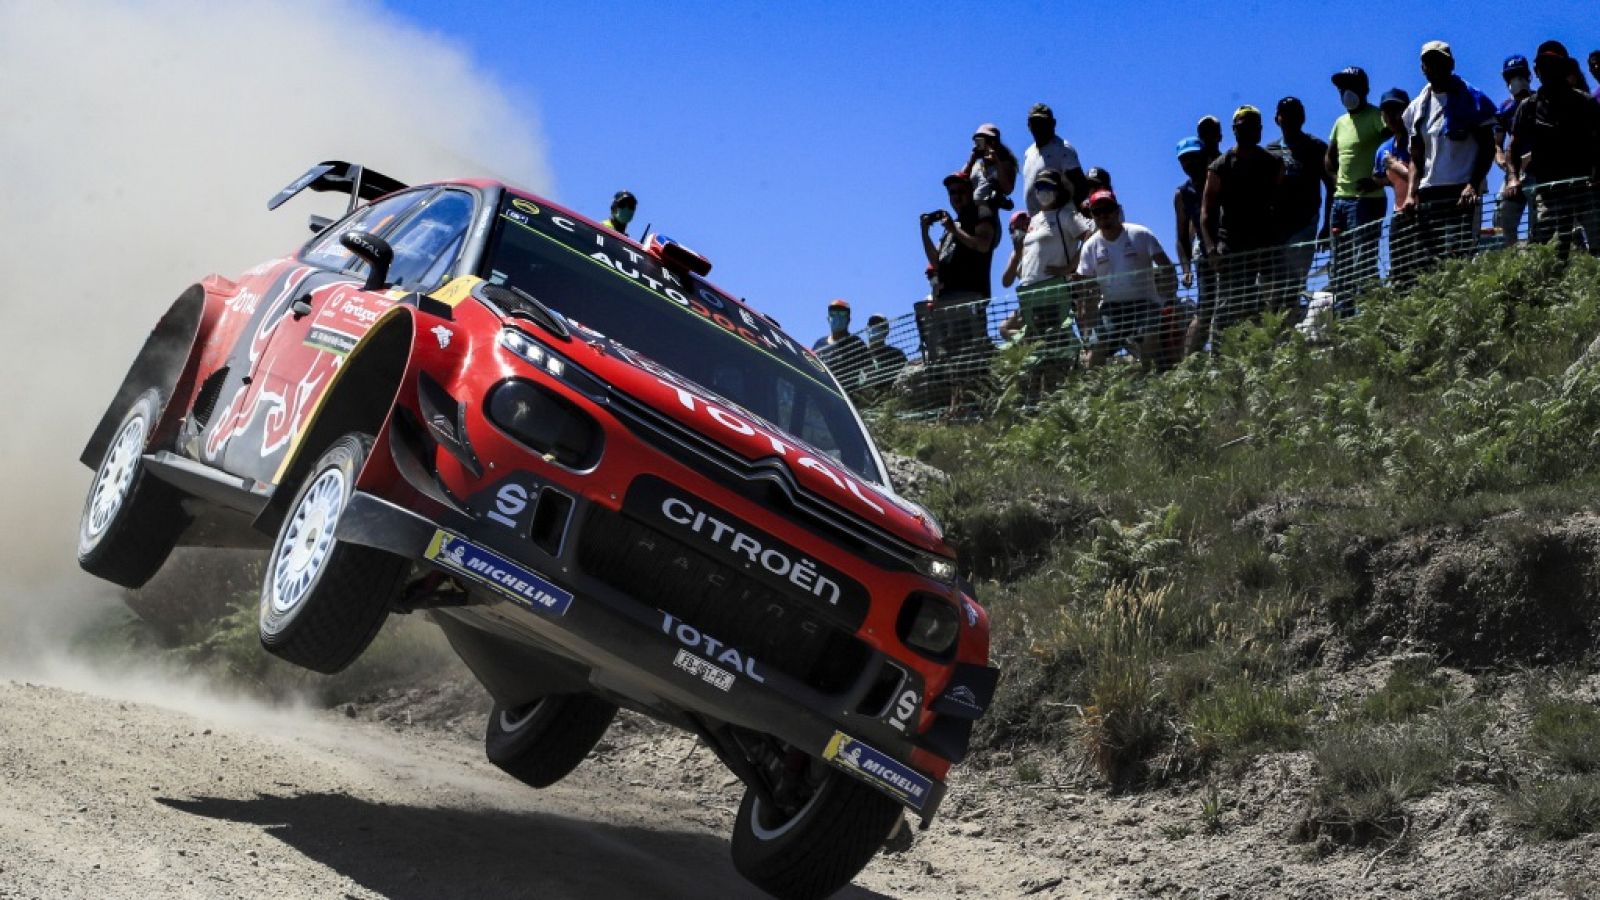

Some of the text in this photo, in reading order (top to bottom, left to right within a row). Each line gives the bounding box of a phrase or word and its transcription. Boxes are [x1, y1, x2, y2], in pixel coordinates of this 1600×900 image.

[347, 233, 381, 257] TOTAL
[658, 379, 884, 515] TOTAL
[467, 557, 557, 607] MICHELIN
[662, 498, 841, 605] CITROËN
[657, 608, 765, 684] TOTAL
[863, 758, 925, 797] MICHELIN
